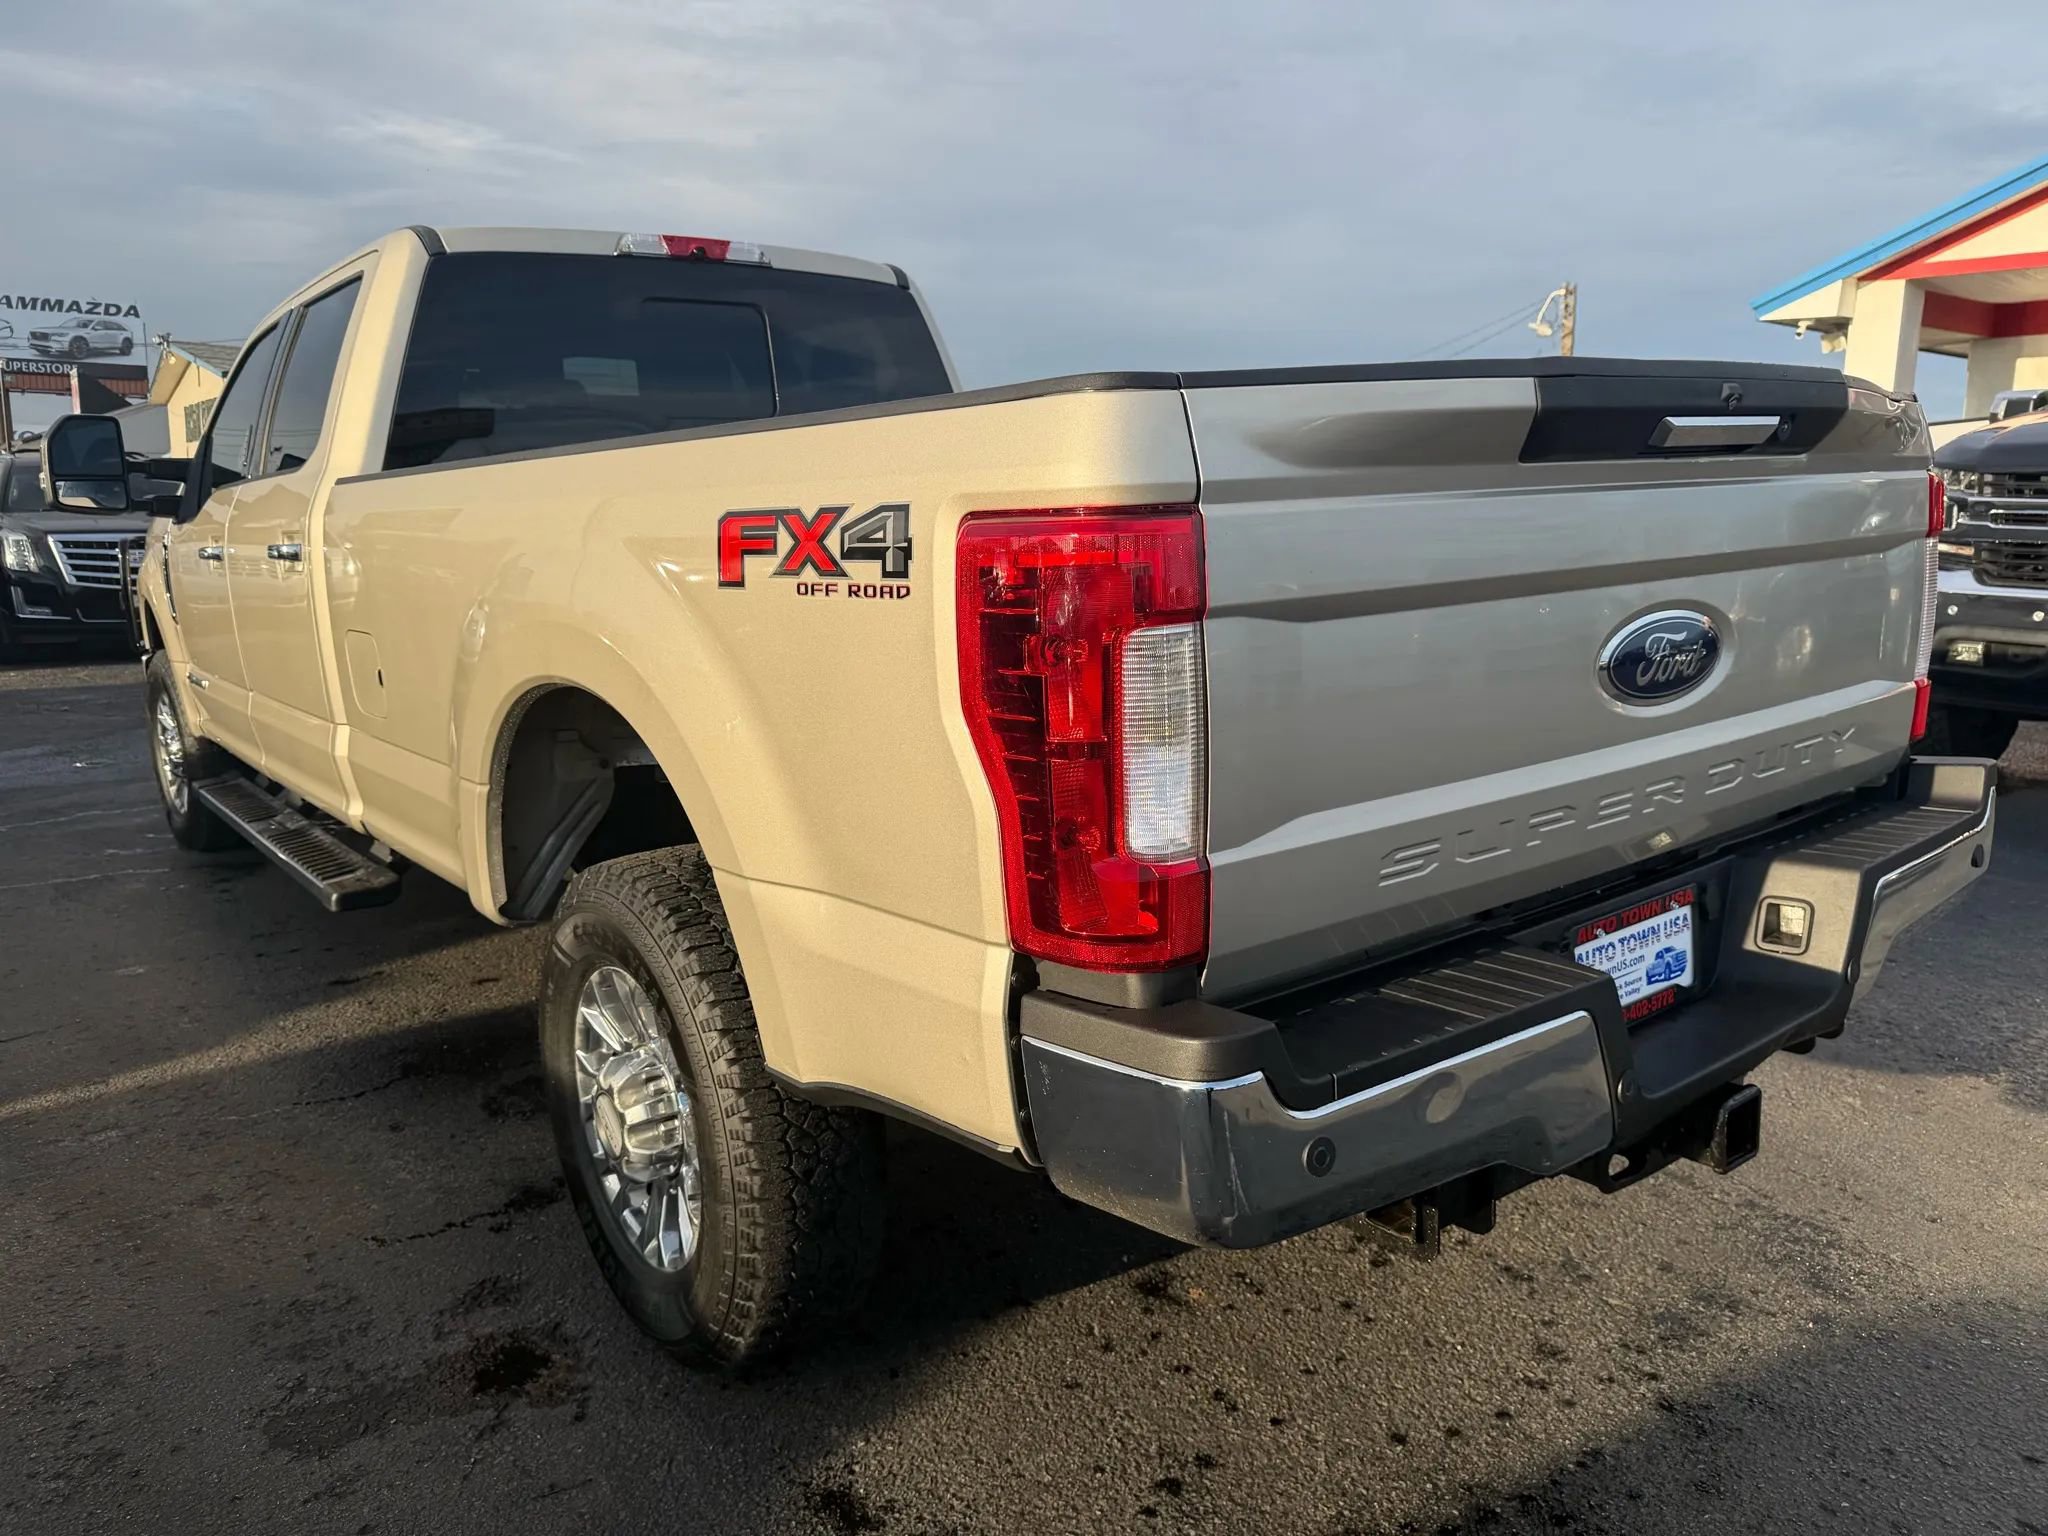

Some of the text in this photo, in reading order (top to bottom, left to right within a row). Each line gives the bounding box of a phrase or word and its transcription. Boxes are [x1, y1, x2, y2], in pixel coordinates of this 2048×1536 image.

[2, 360, 79, 375] UPERSTOR
[718, 501, 914, 589] FX4
[796, 582, 911, 600] OFF ROAD
[1636, 631, 1707, 687] Ford
[1378, 726, 1856, 887] SUPER DUTY
[1576, 913, 1691, 967] AUTO TOWN USA
[1577, 889, 1694, 944] AUTO TOWN USA
[1624, 975, 1642, 987] Source
[1624, 986, 1641, 997] Valley
